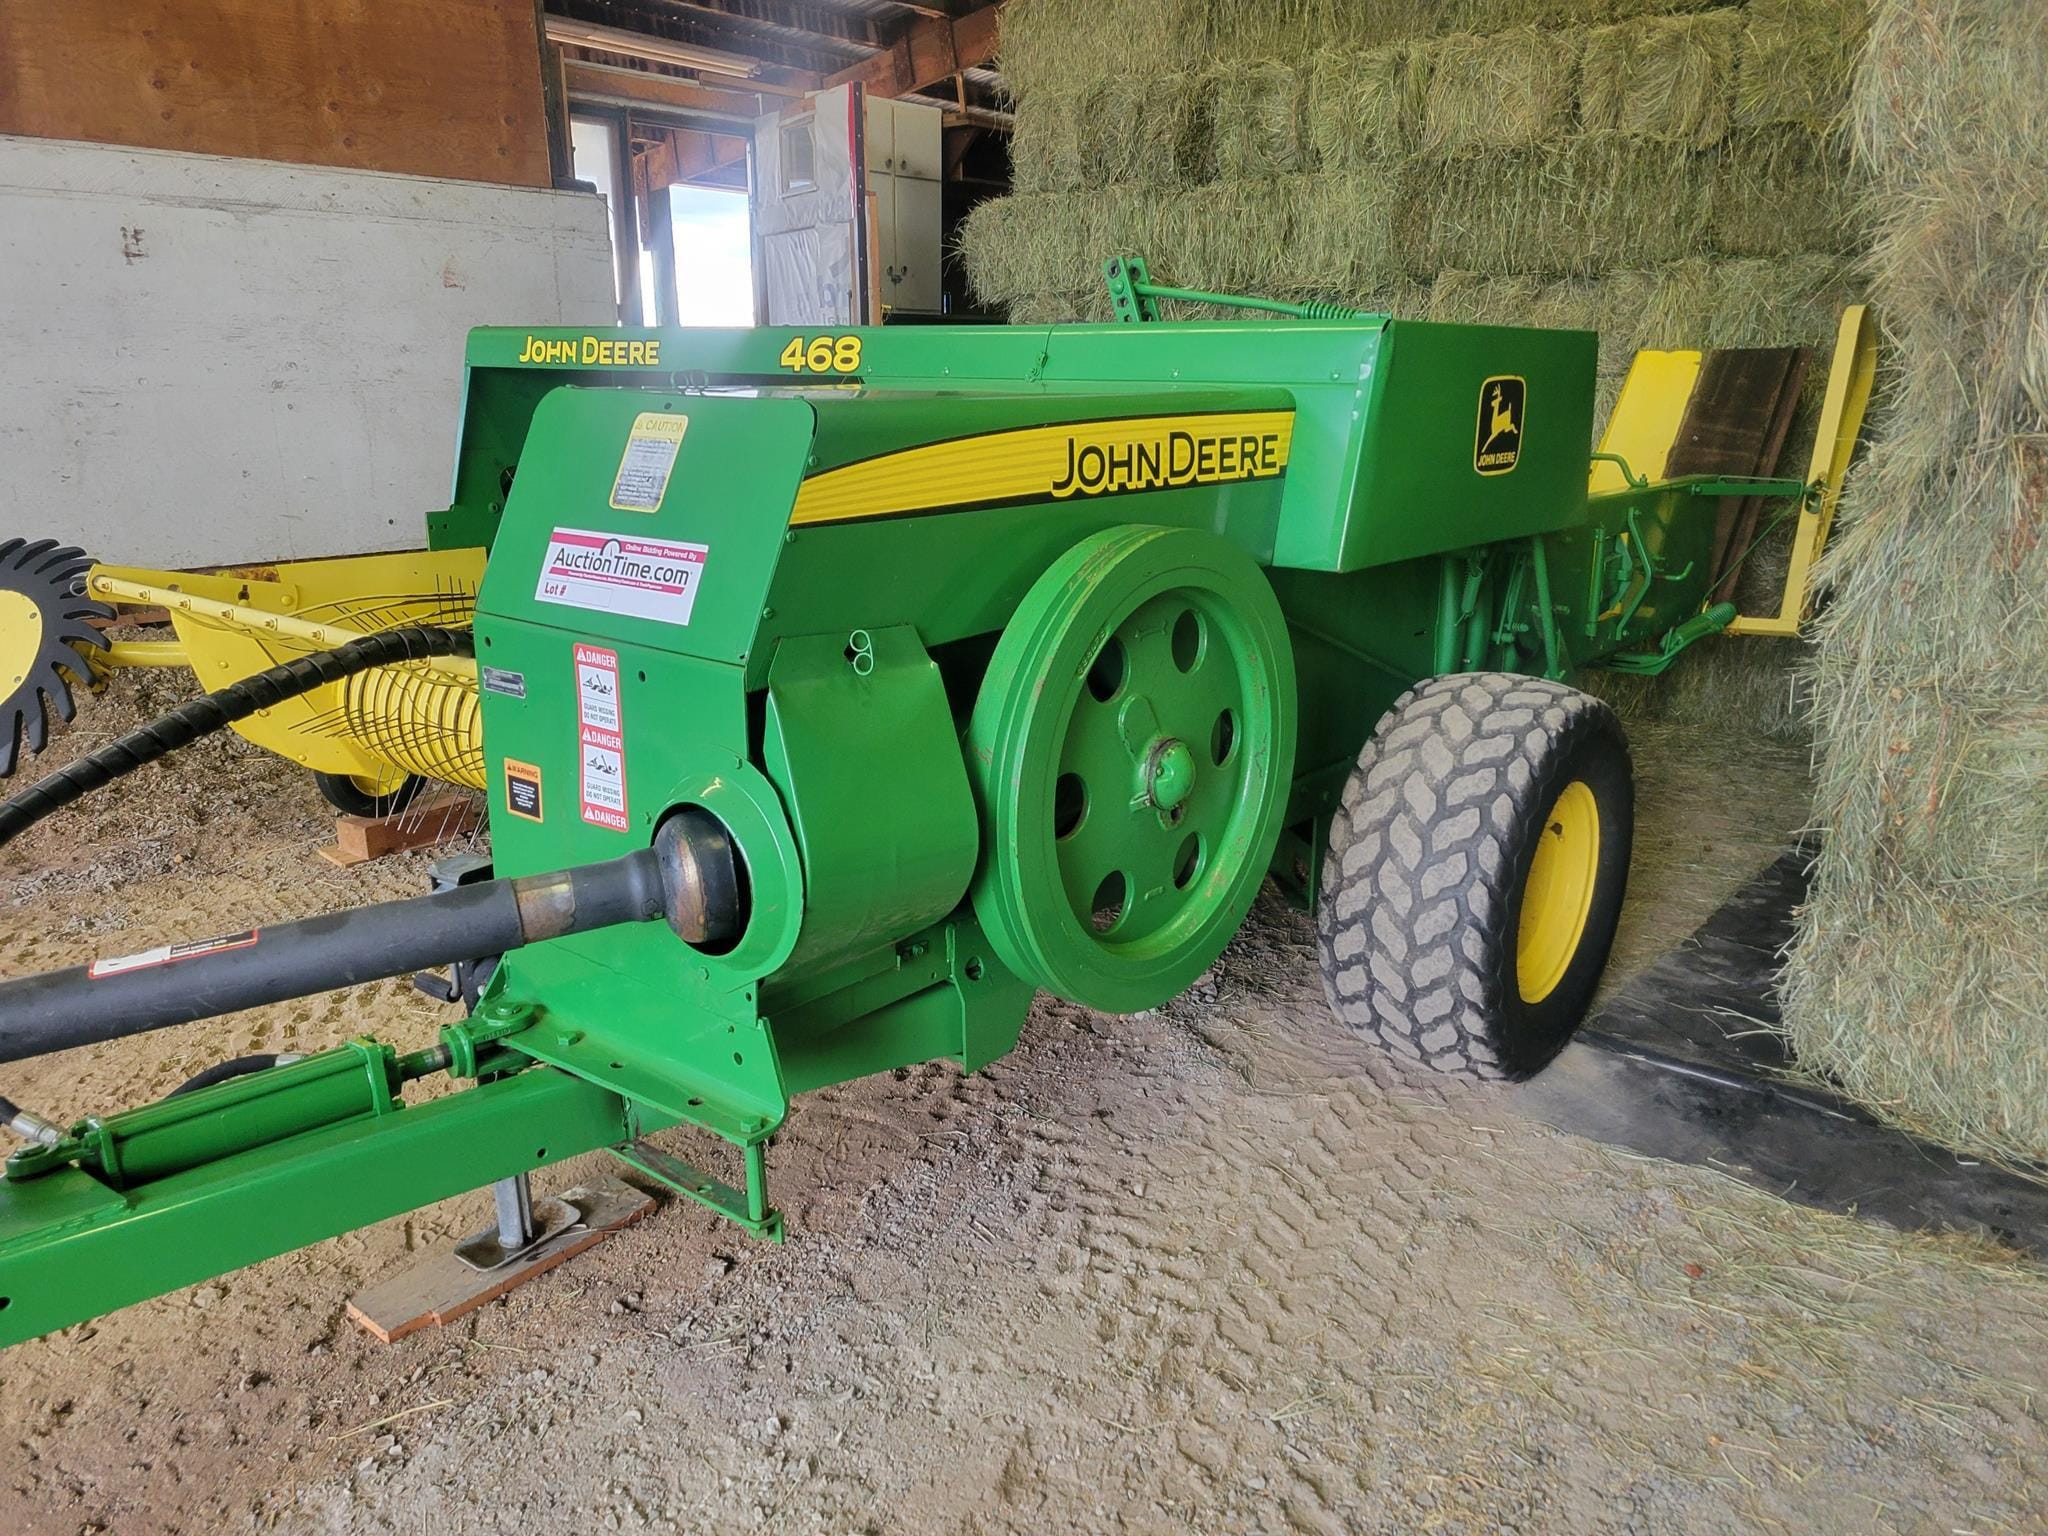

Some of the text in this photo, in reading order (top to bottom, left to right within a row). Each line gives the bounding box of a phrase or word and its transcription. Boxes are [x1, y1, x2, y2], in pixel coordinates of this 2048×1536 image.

[519, 335, 660, 365] JOHN DEERE
[780, 335, 862, 373] 468
[646, 419, 683, 433] CAUTION
[1052, 431, 1279, 494] JOHN DEERE
[1478, 451, 1516, 467] JOHN DEERE
[625, 543, 698, 561] Online Bidding Powered By
[553, 548, 690, 586] AuctionTime.com
[544, 582, 567, 597] Lot #
[586, 650, 616, 668] DANGER
[590, 712, 598, 721] NOT
[591, 731, 622, 749] DANGER
[511, 766, 539, 779] WARNING
[586, 782, 601, 792] GUARD
[593, 792, 602, 801] NOT
[602, 795, 621, 806] OPERATE
[594, 810, 627, 829] DANGER
